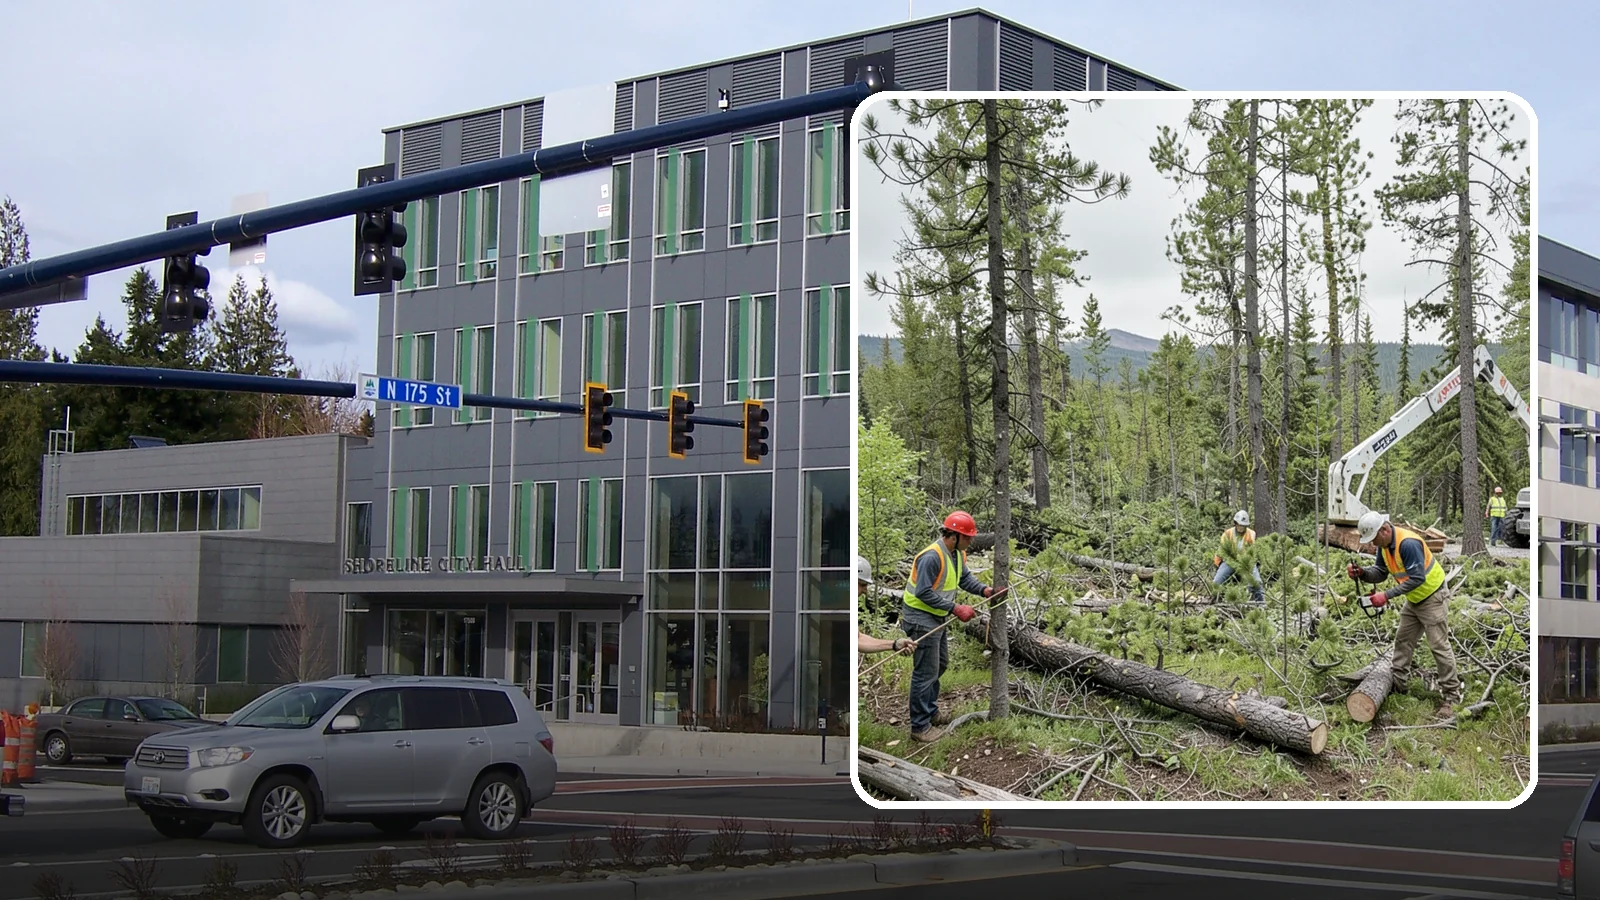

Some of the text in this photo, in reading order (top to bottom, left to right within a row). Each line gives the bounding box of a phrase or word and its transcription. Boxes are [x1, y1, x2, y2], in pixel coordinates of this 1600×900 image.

[387, 380, 451, 406] N 175 St
[344, 555, 526, 574] SHORELINE CITY HALL
